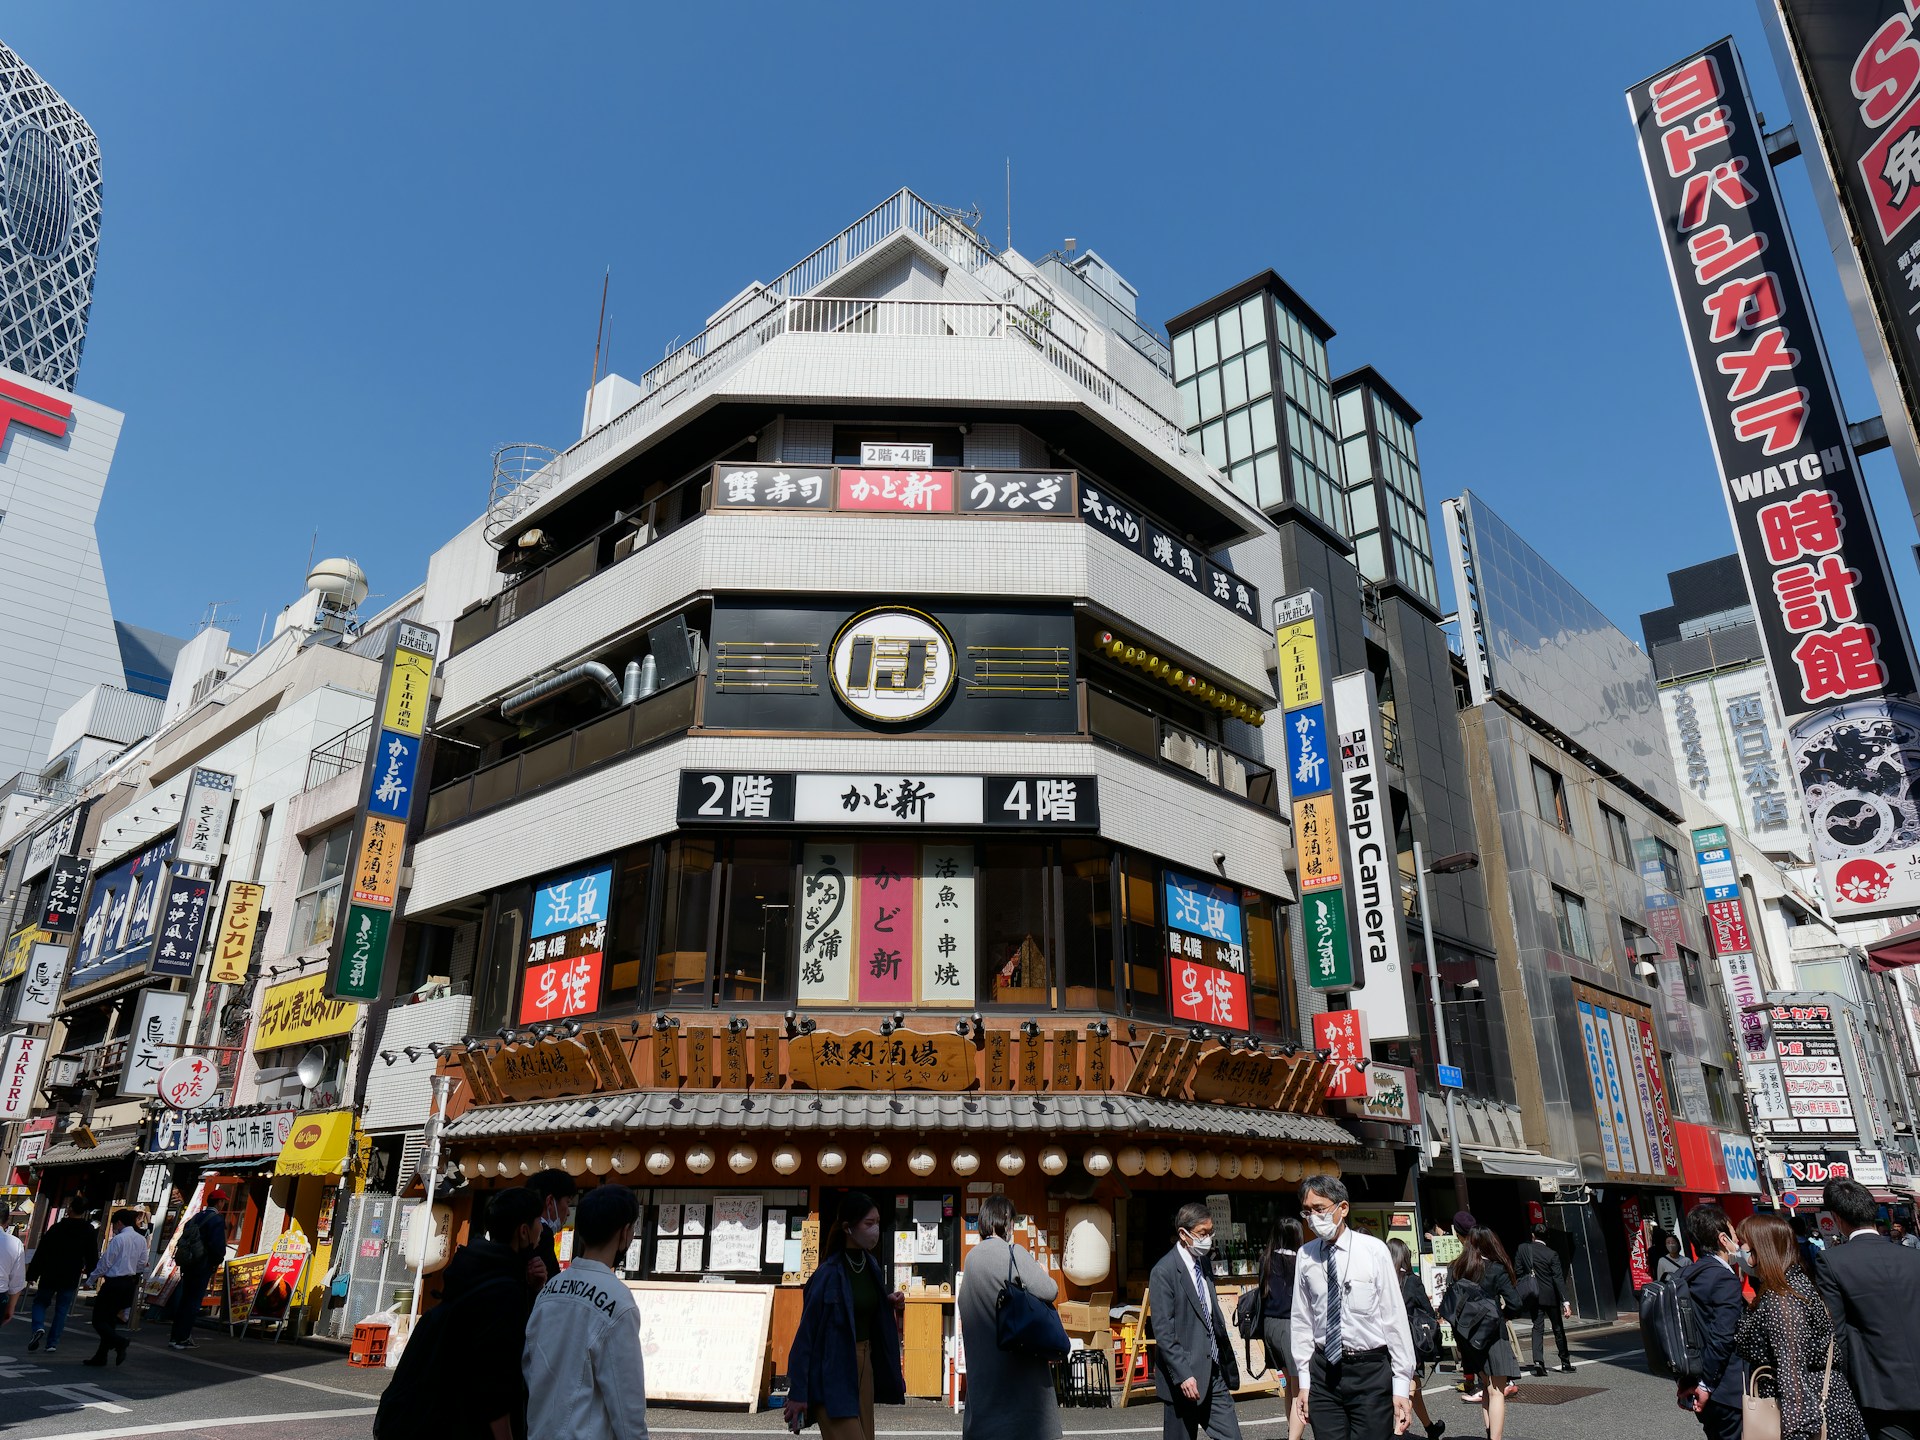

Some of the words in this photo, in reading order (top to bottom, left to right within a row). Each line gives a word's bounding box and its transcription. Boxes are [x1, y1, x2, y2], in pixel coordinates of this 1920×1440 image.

[1649, 55, 1811, 457] ヨドバシカメラ
[867, 448, 928, 464] 2階・4階
[1730, 446, 1846, 503] WATCH
[723, 471, 824, 505] 蟹寿司
[850, 475, 942, 512] かど新
[970, 474, 1064, 511] うなぎ
[1082, 488, 1140, 543] 天ぷら
[1212, 571, 1253, 616] 活魚
[1283, 597, 1303, 611] 新宿
[1757, 489, 1890, 705] 時計館
[408, 628, 428, 641] 新宿
[1295, 713, 1325, 787] かど新
[1340, 731, 1364, 745] AP
[1342, 744, 1366, 759] AM
[1727, 692, 1790, 825] 西口本店
[375, 737, 410, 811] かど新
[1344, 757, 1369, 770] RA
[697, 774, 774, 819] 2階
[841, 778, 936, 824] かど新
[1003, 779, 1078, 823] 4階
[1348, 773, 1374, 840] Map
[191, 805, 215, 852] さくら水産
[1301, 802, 1322, 877] 熱烈酒場
[204, 855, 216, 863] 5F
[361, 820, 387, 892] 熱烈酒場
[1703, 851, 1725, 862] CBR
[47, 872, 74, 913] すみれ
[545, 872, 600, 927] 活魚
[1358, 842, 1388, 964] Camera
[1714, 888, 1730, 899] 5F
[185, 888, 205, 943] 炉端とおでん
[223, 885, 257, 971] 牛すじカレー
[580, 920, 607, 953] かど新
[869, 865, 903, 981] かど新
[935, 857, 961, 987] 活魚・串焼
[179, 951, 193, 960] 3F
[1216, 943, 1245, 974] かど新
[5, 1039, 35, 1112] RAKERU
[505, 1047, 568, 1081] 熱烈酒場
[759, 1033, 775, 1085] 牛すじ煮
[815, 1040, 939, 1068] 熱烈酒場
[990, 1034, 1005, 1086] 焼きとり
[1212, 1058, 1274, 1087] 熱烈酒場
[1584, 1022, 1604, 1101] GiGO
[1600, 1027, 1619, 1103] GiGO
[171, 1081, 190, 1105] めん
[190, 1060, 209, 1097] わんたん
[870, 1068, 950, 1085] ドンちゃん
[225, 1120, 275, 1150] 広州市場
[1723, 1142, 1758, 1182] GiGO
